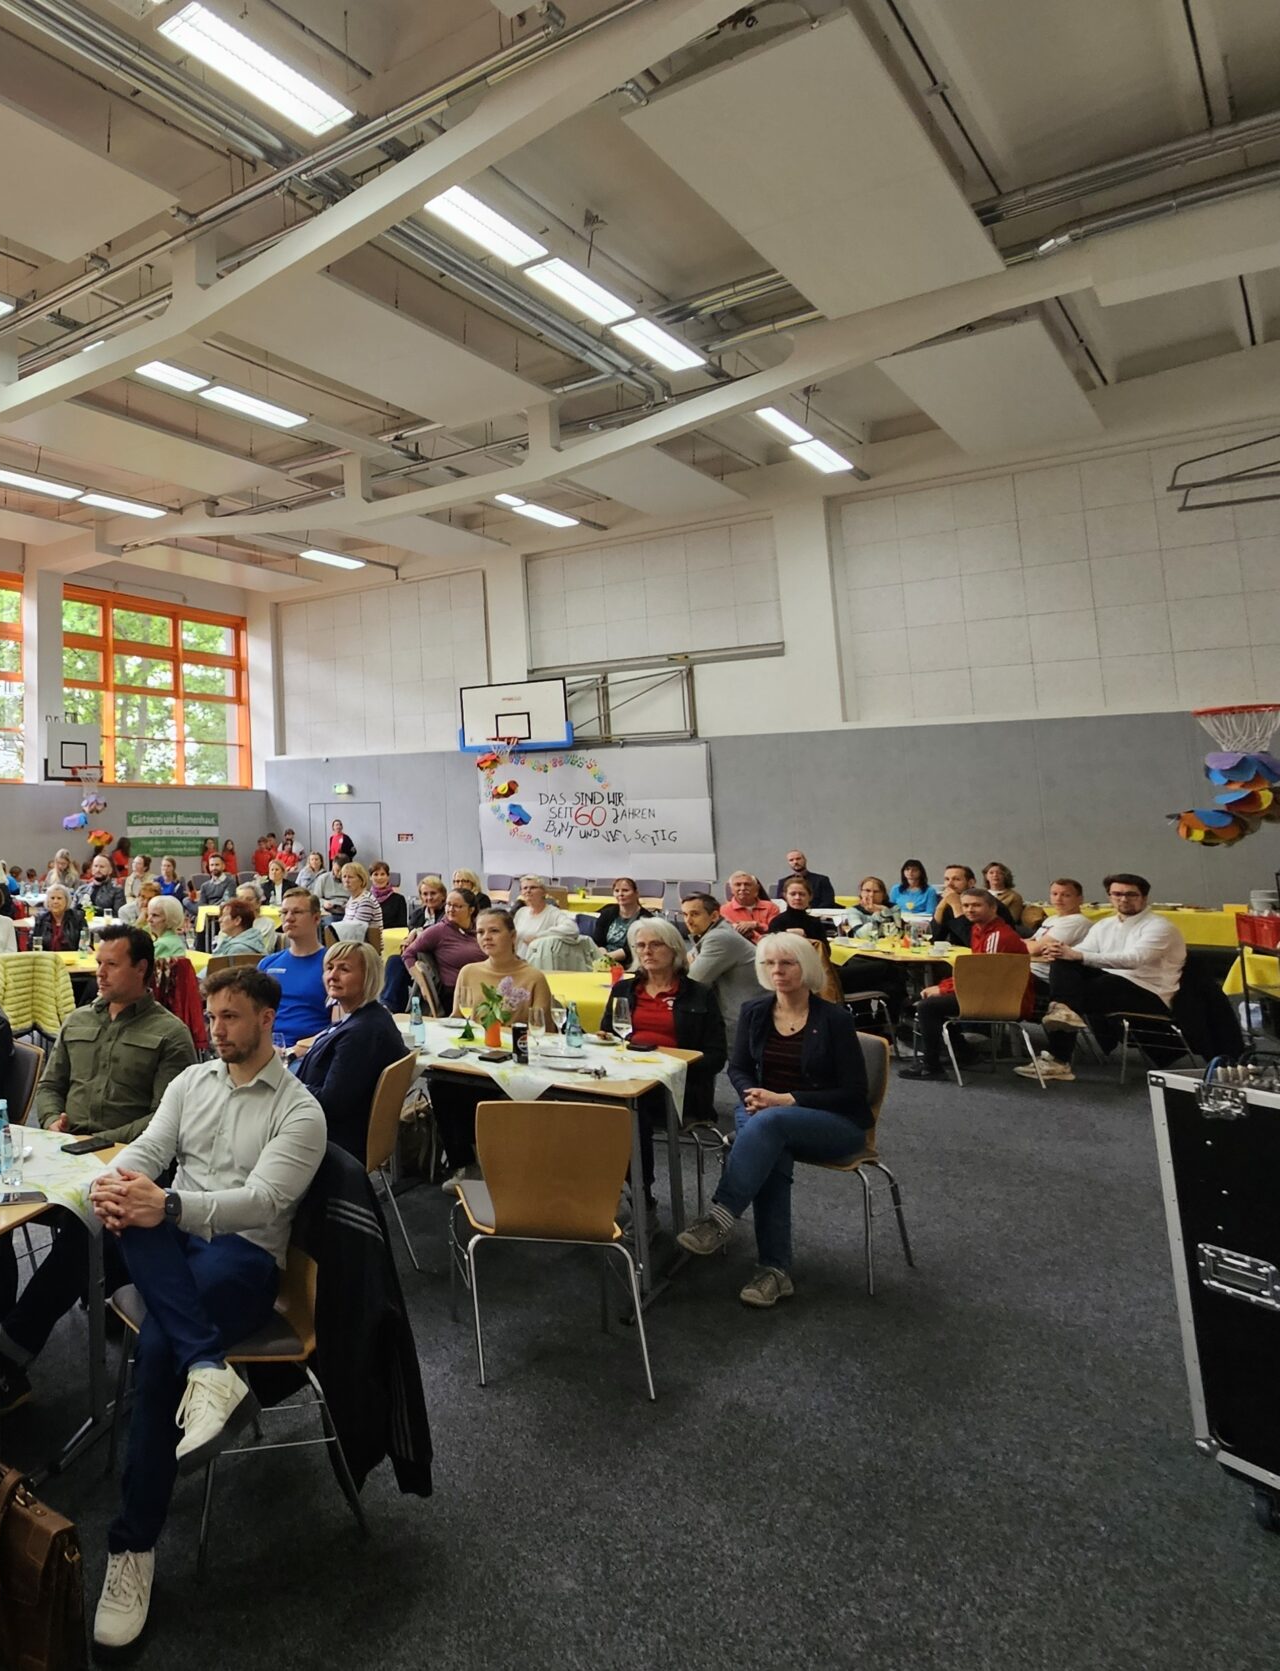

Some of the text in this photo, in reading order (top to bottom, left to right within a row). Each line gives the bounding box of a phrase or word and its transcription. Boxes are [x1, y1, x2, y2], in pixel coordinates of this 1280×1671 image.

[539, 791, 625, 807] DAS SIND WIR
[549, 805, 656, 827] SEIT 60 JAHREN
[545, 820, 578, 839] BUNT
[579, 828, 600, 840] UND
